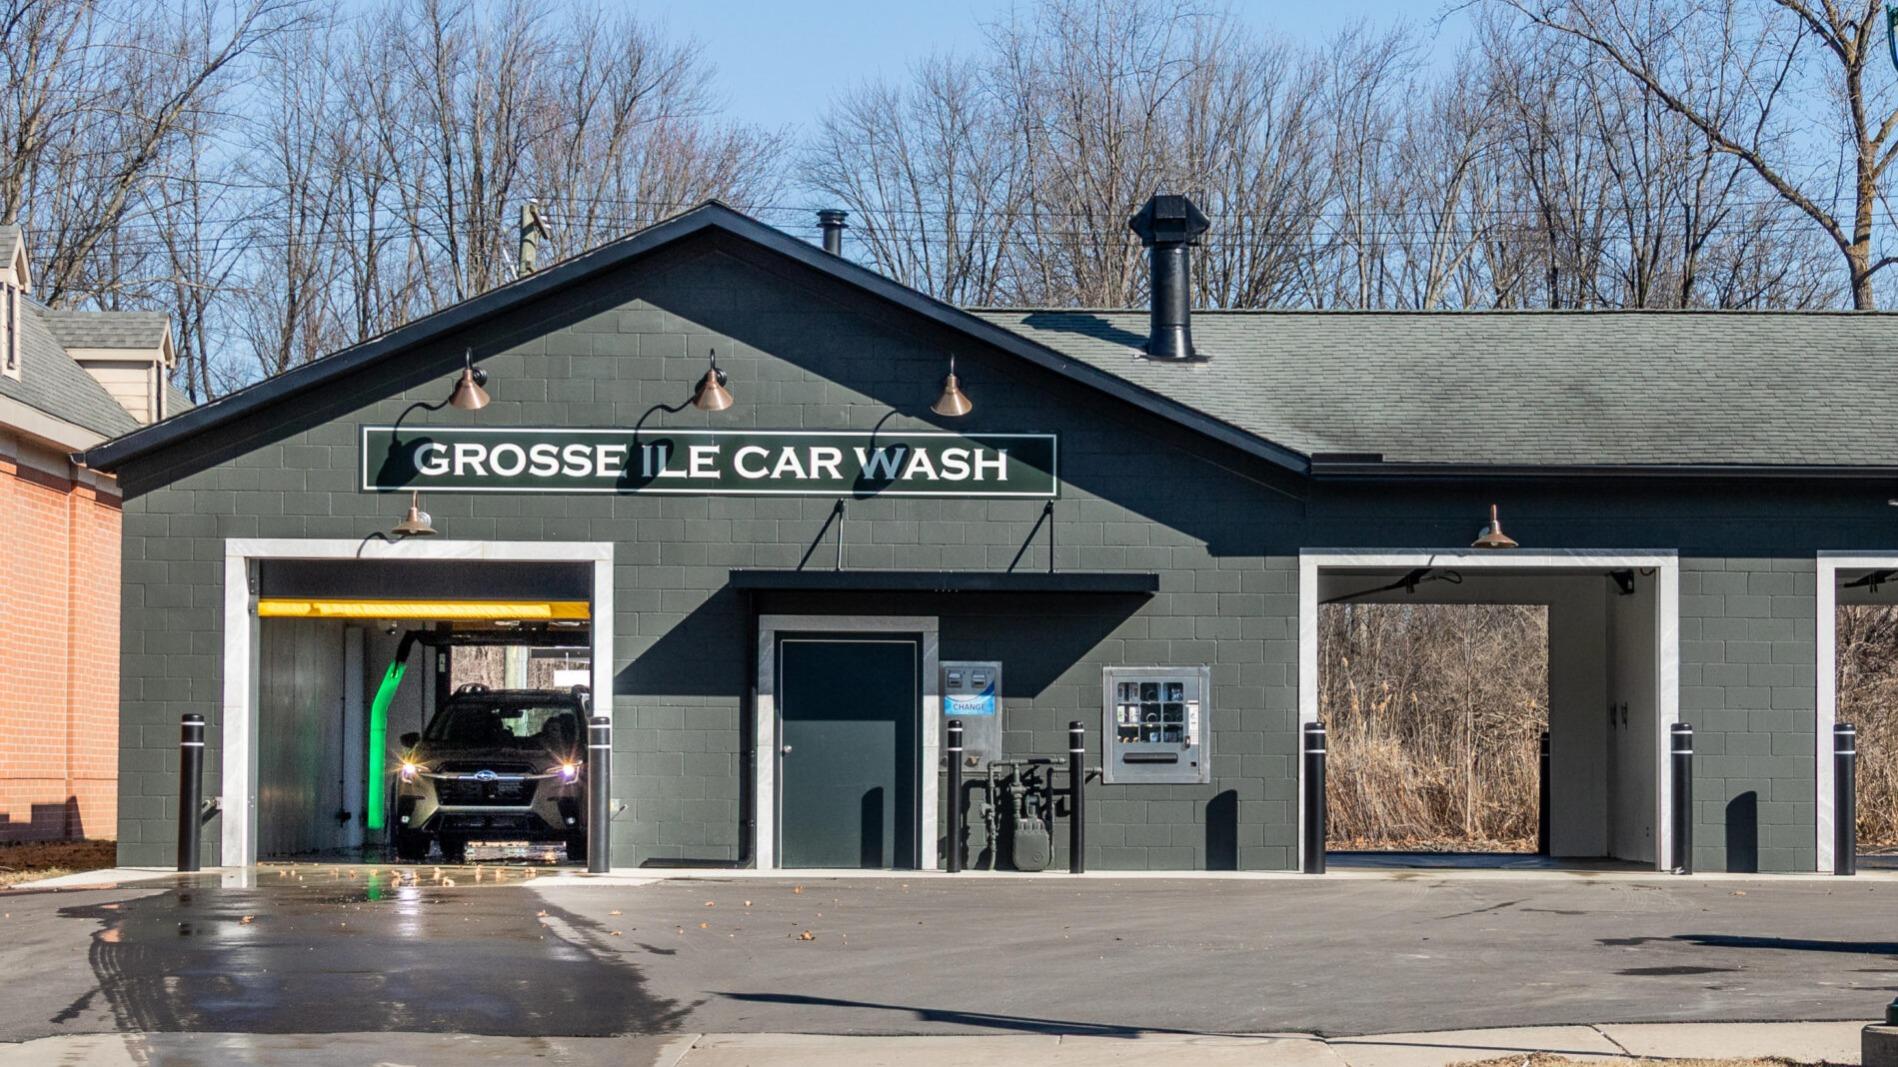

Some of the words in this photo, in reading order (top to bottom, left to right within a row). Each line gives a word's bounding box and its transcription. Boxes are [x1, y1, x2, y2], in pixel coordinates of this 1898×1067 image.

[414, 442, 627, 477] GROSSE
[642, 445, 721, 479] ILE
[734, 446, 843, 479] CAR
[853, 447, 1008, 481] WASH
[953, 703, 985, 711] CHANGE
